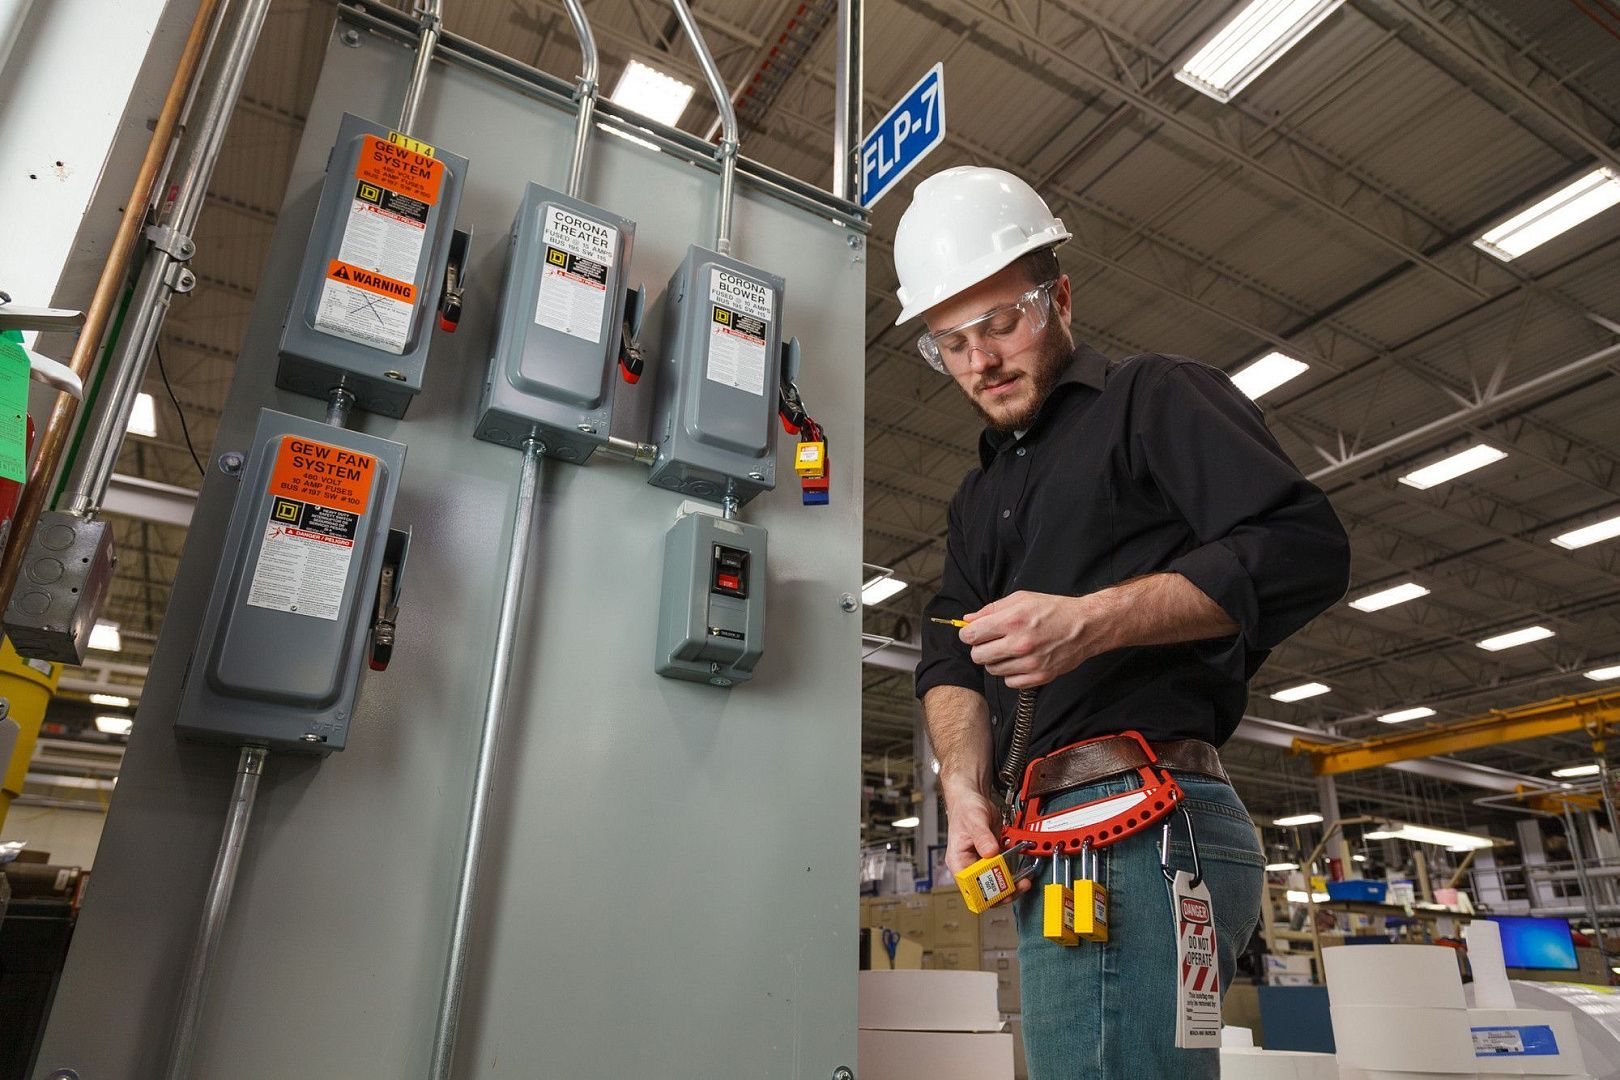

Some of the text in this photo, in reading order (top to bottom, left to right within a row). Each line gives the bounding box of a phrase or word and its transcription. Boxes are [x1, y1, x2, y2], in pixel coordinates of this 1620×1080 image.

[863, 82, 938, 195] FLP-7
[375, 141, 434, 168] GEW UV
[364, 170, 379, 180] BUS
[374, 152, 430, 179] SYSTEM
[399, 171, 415, 180] VOLT
[383, 171, 400, 180] AMP
[402, 178, 424, 190] FUSES
[554, 221, 608, 248] TREATER
[555, 212, 608, 238] CORONA
[545, 228, 570, 242] FUSED
[592, 246, 612, 258] AMPS
[550, 238, 566, 247] BUS
[582, 248, 594, 258] SW
[353, 271, 411, 298] WARNING
[720, 272, 766, 295] CORONA
[720, 282, 765, 304] BLOWER
[712, 288, 734, 300] FUSED
[752, 304, 770, 314] AMPS
[716, 296, 730, 306] BUS
[744, 306, 754, 314] SW
[290, 441, 369, 469] GEW FAN
[293, 456, 360, 481] SYSTEM
[304, 473, 342, 486] 480 VOLT
[304, 480, 322, 488] AMP
[326, 484, 352, 496] FUSES
[280, 482, 298, 492] BUS
[302, 486, 320, 496] #197
[324, 492, 337, 500] SW
[296, 531, 320, 540] DANGER
[324, 538, 350, 546] PELIGRO
[1183, 902, 1207, 918] DANGER
[1189, 936, 1208, 950] DO NOT
[1187, 952, 1212, 967] OPERATE
